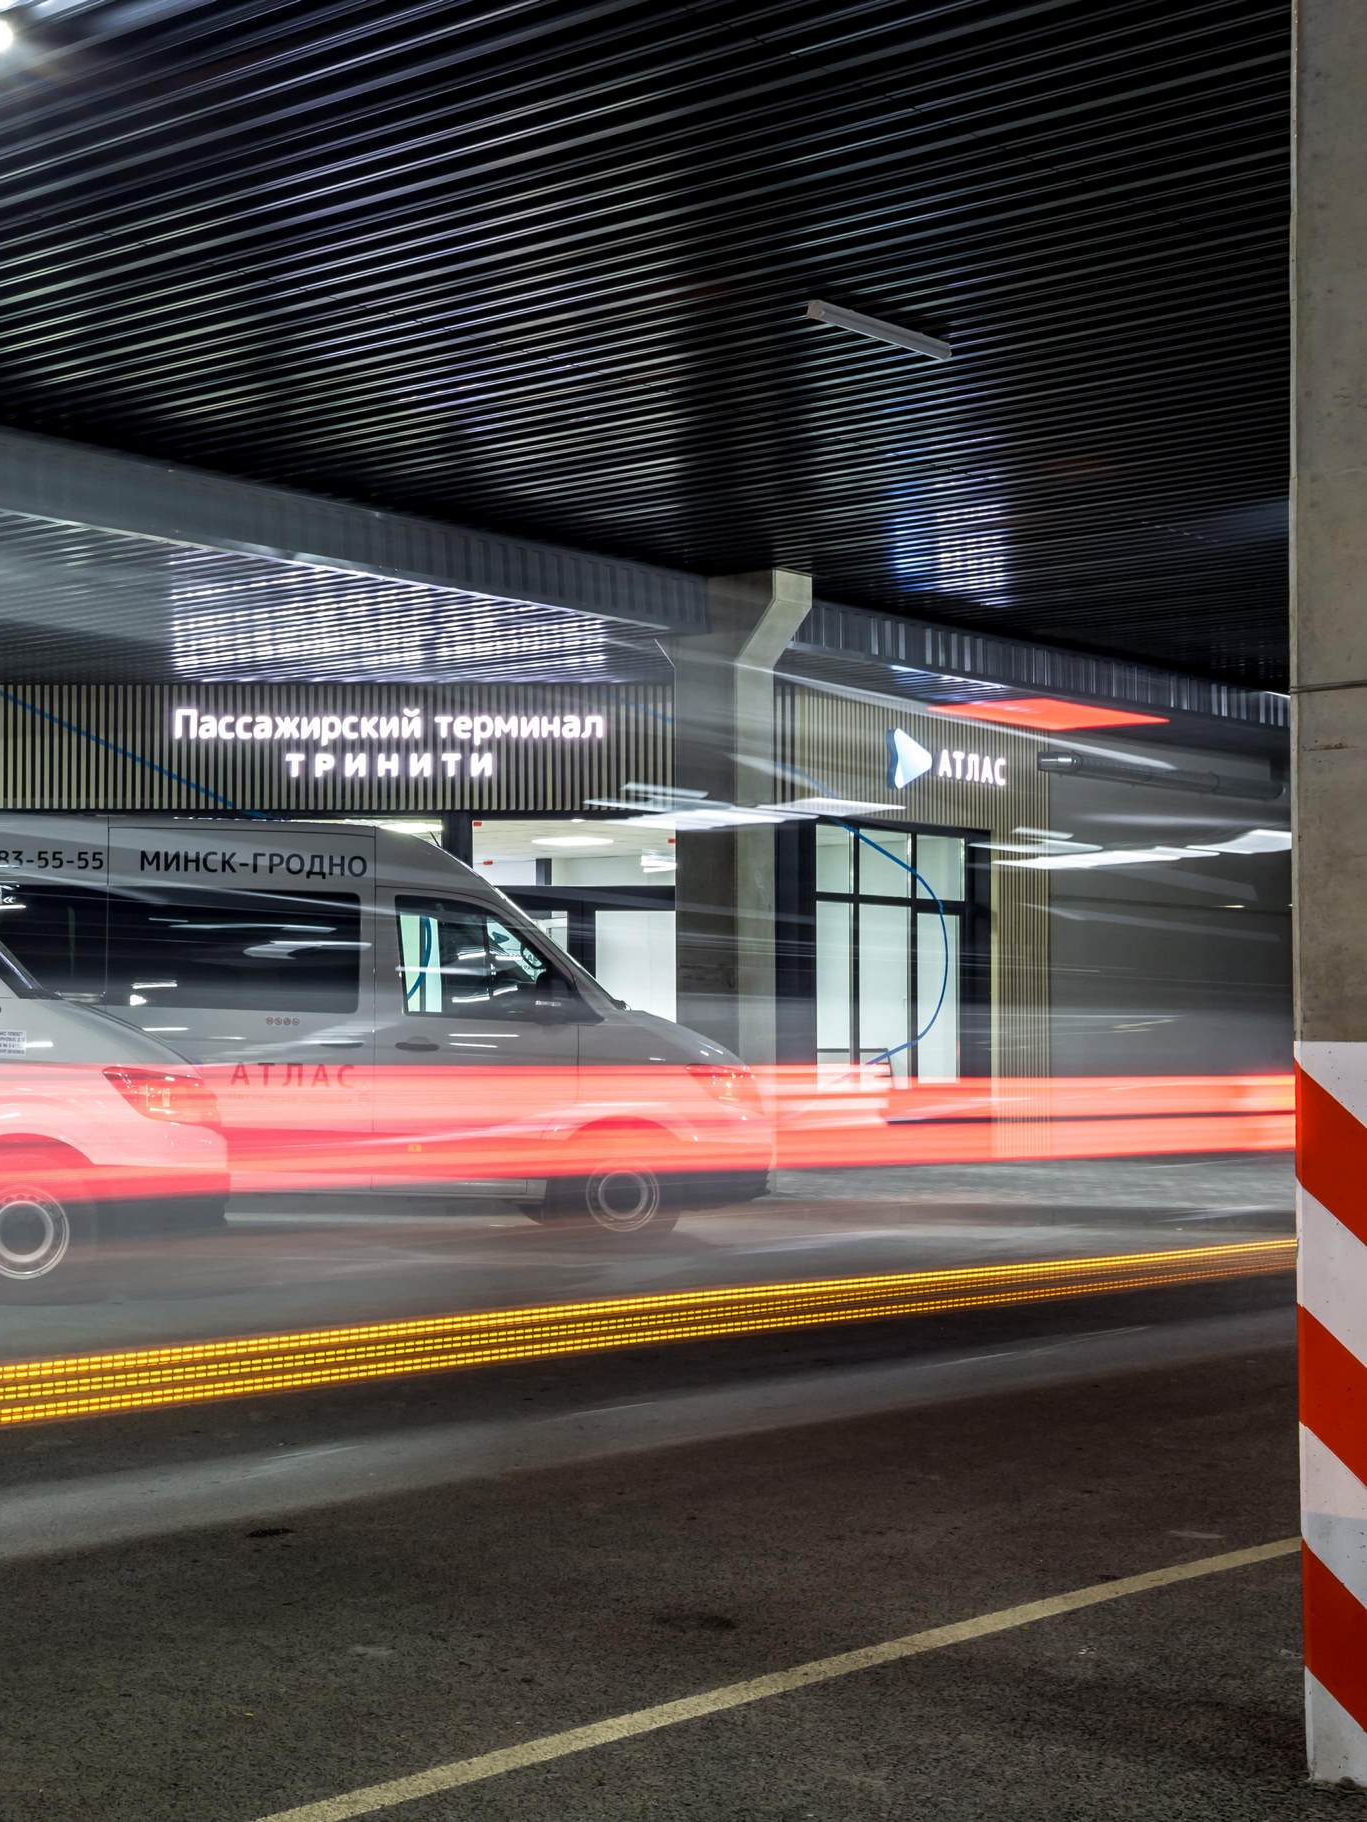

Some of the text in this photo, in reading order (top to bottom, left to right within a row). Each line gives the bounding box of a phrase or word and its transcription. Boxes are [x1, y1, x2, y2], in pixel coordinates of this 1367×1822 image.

[173, 707, 604, 747] Пассажирский терминал
[284, 752, 495, 778] ТРИНИТИ
[937, 748, 1007, 787] АТЛАС
[139, 849, 368, 880] МИНСК-ГРОДНО
[230, 1060, 355, 1089] АТЛАС
